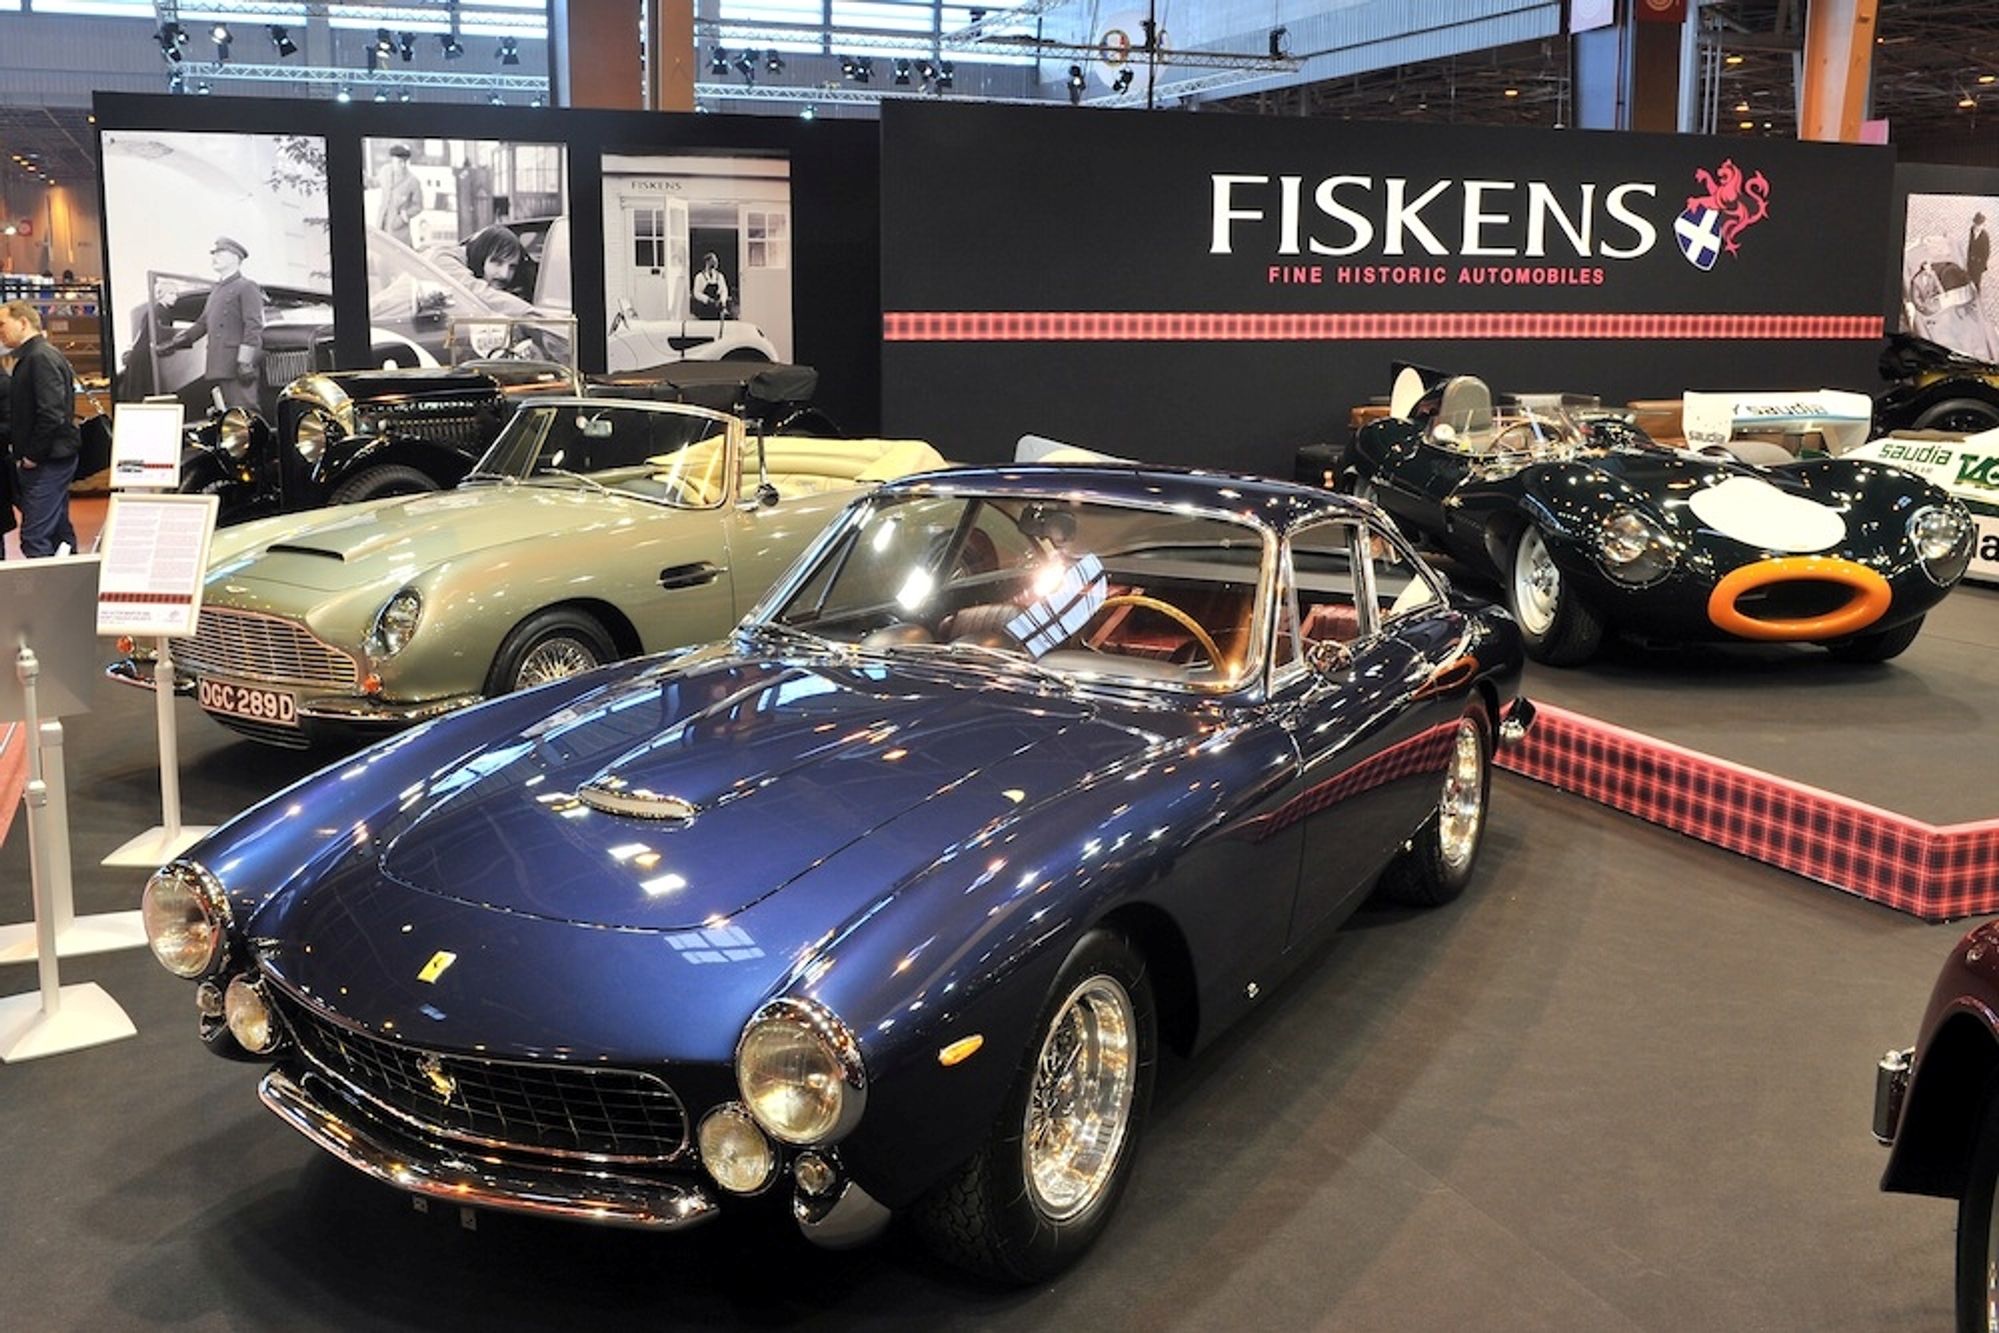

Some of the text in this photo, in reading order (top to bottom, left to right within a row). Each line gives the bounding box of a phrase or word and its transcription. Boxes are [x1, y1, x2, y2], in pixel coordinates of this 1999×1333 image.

[631, 180, 683, 191] FISKENS
[1209, 173, 1659, 258] FISKENS
[1268, 266, 1605, 286] FINE HISTORIC AUTOMOBILES
[1878, 444, 1953, 466] saudia
[201, 680, 294, 722] OGC 289D
